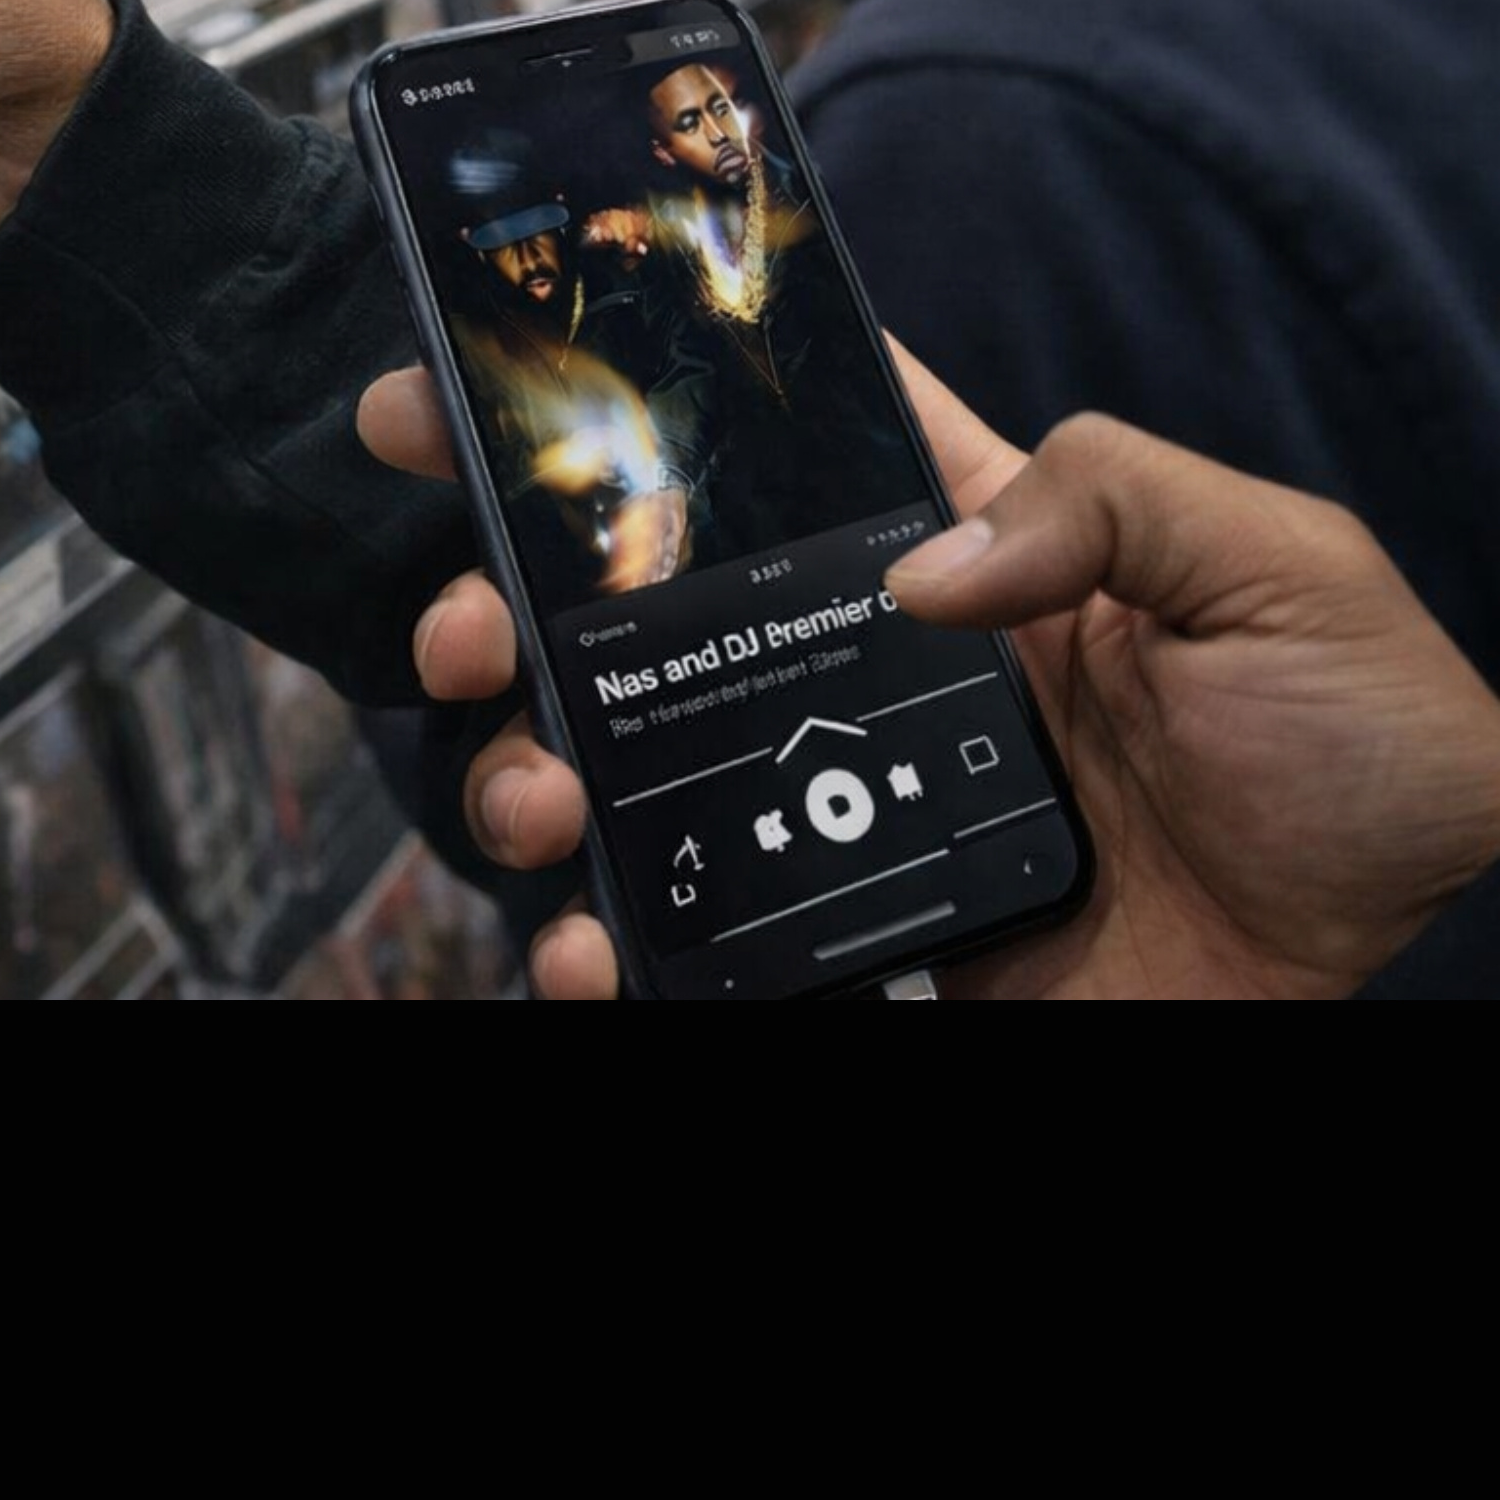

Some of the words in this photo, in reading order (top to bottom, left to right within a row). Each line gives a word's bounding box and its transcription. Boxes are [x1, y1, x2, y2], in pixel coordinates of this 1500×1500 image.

[594, 668, 659, 706] Nas
[663, 639, 721, 683] and
[722, 626, 760, 663] DJ
